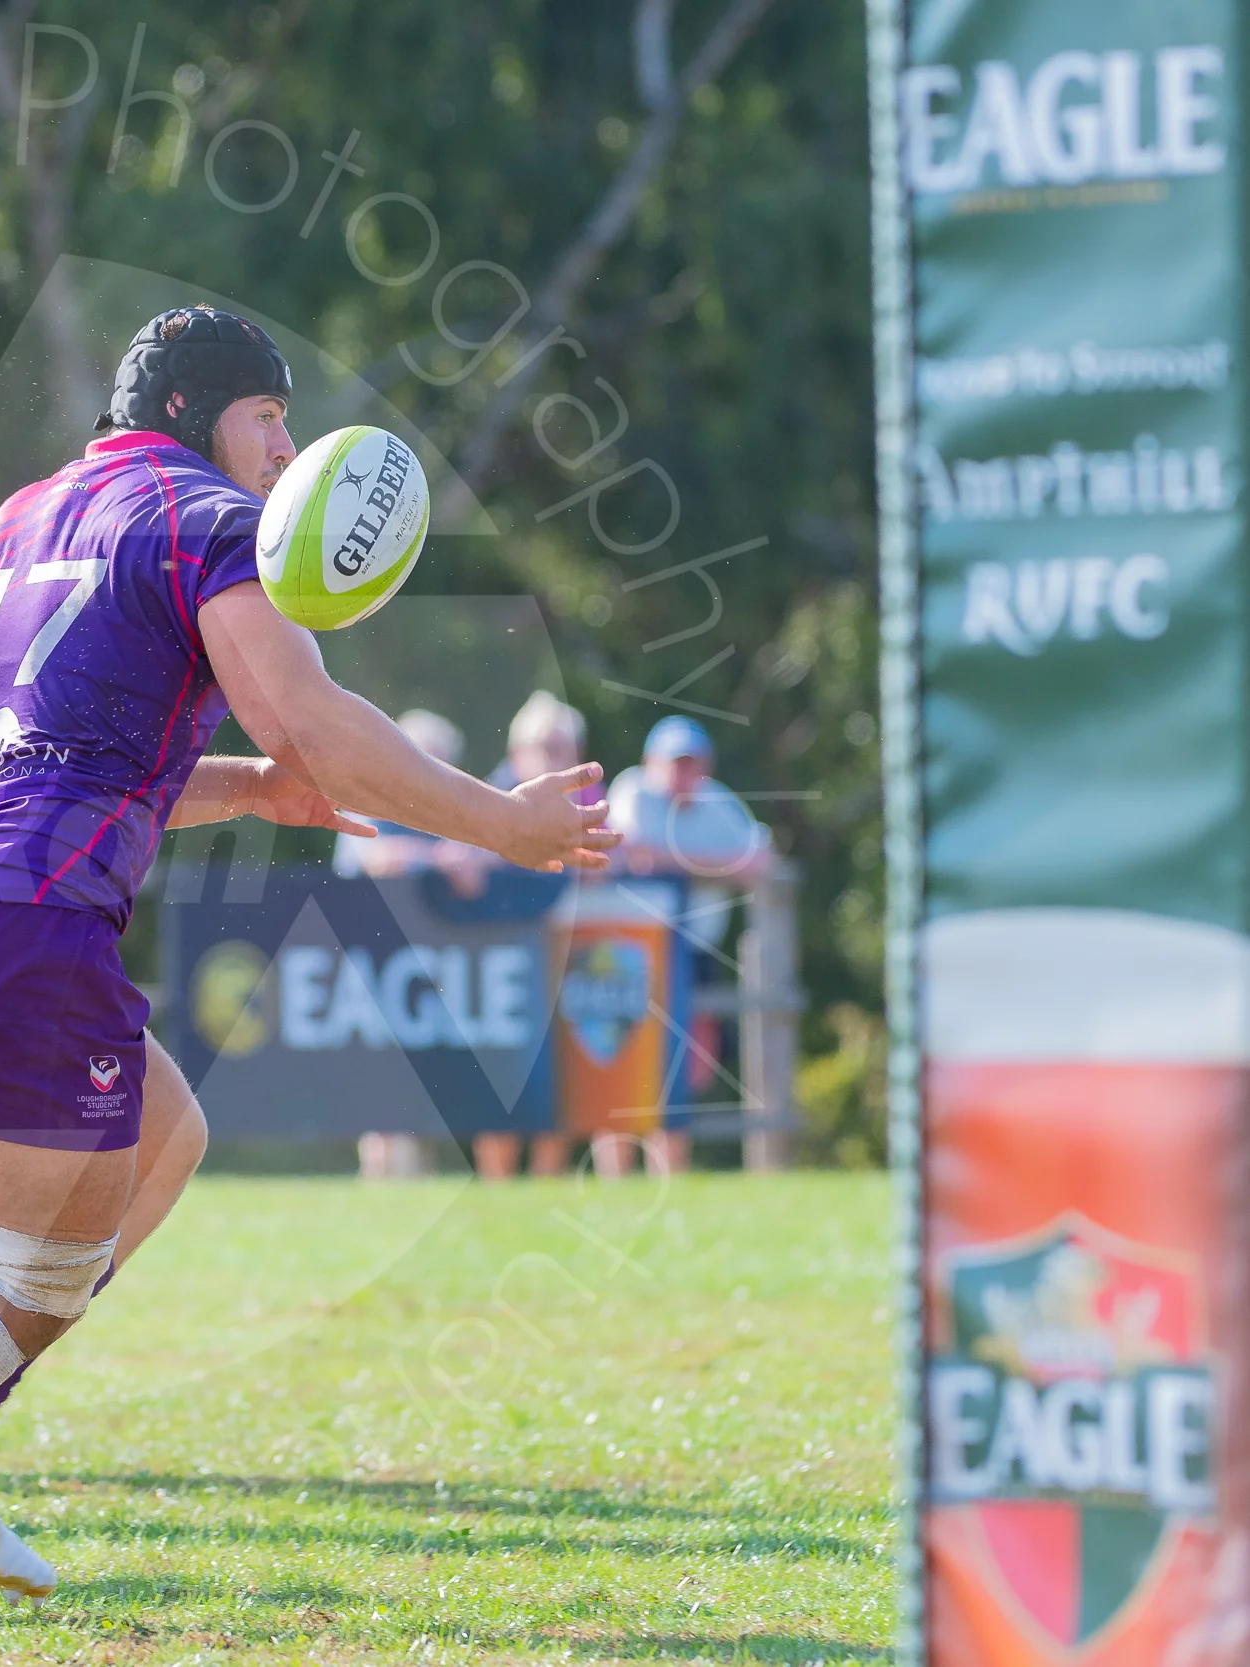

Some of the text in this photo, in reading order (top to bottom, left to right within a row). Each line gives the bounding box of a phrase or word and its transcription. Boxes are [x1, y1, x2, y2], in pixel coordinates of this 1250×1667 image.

[901, 45, 1226, 193] EAGLE
[333, 434, 411, 577] GILBERT
[962, 553, 1170, 656] RUFC
[278, 943, 536, 1050] EAGLE
[76, 1092, 128, 1103] LOUGHBOROUGH
[86, 1100, 121, 1109] STUDENTS
[105, 1109, 125, 1118] UNION
[928, 1364, 1218, 1505] EAGLE
